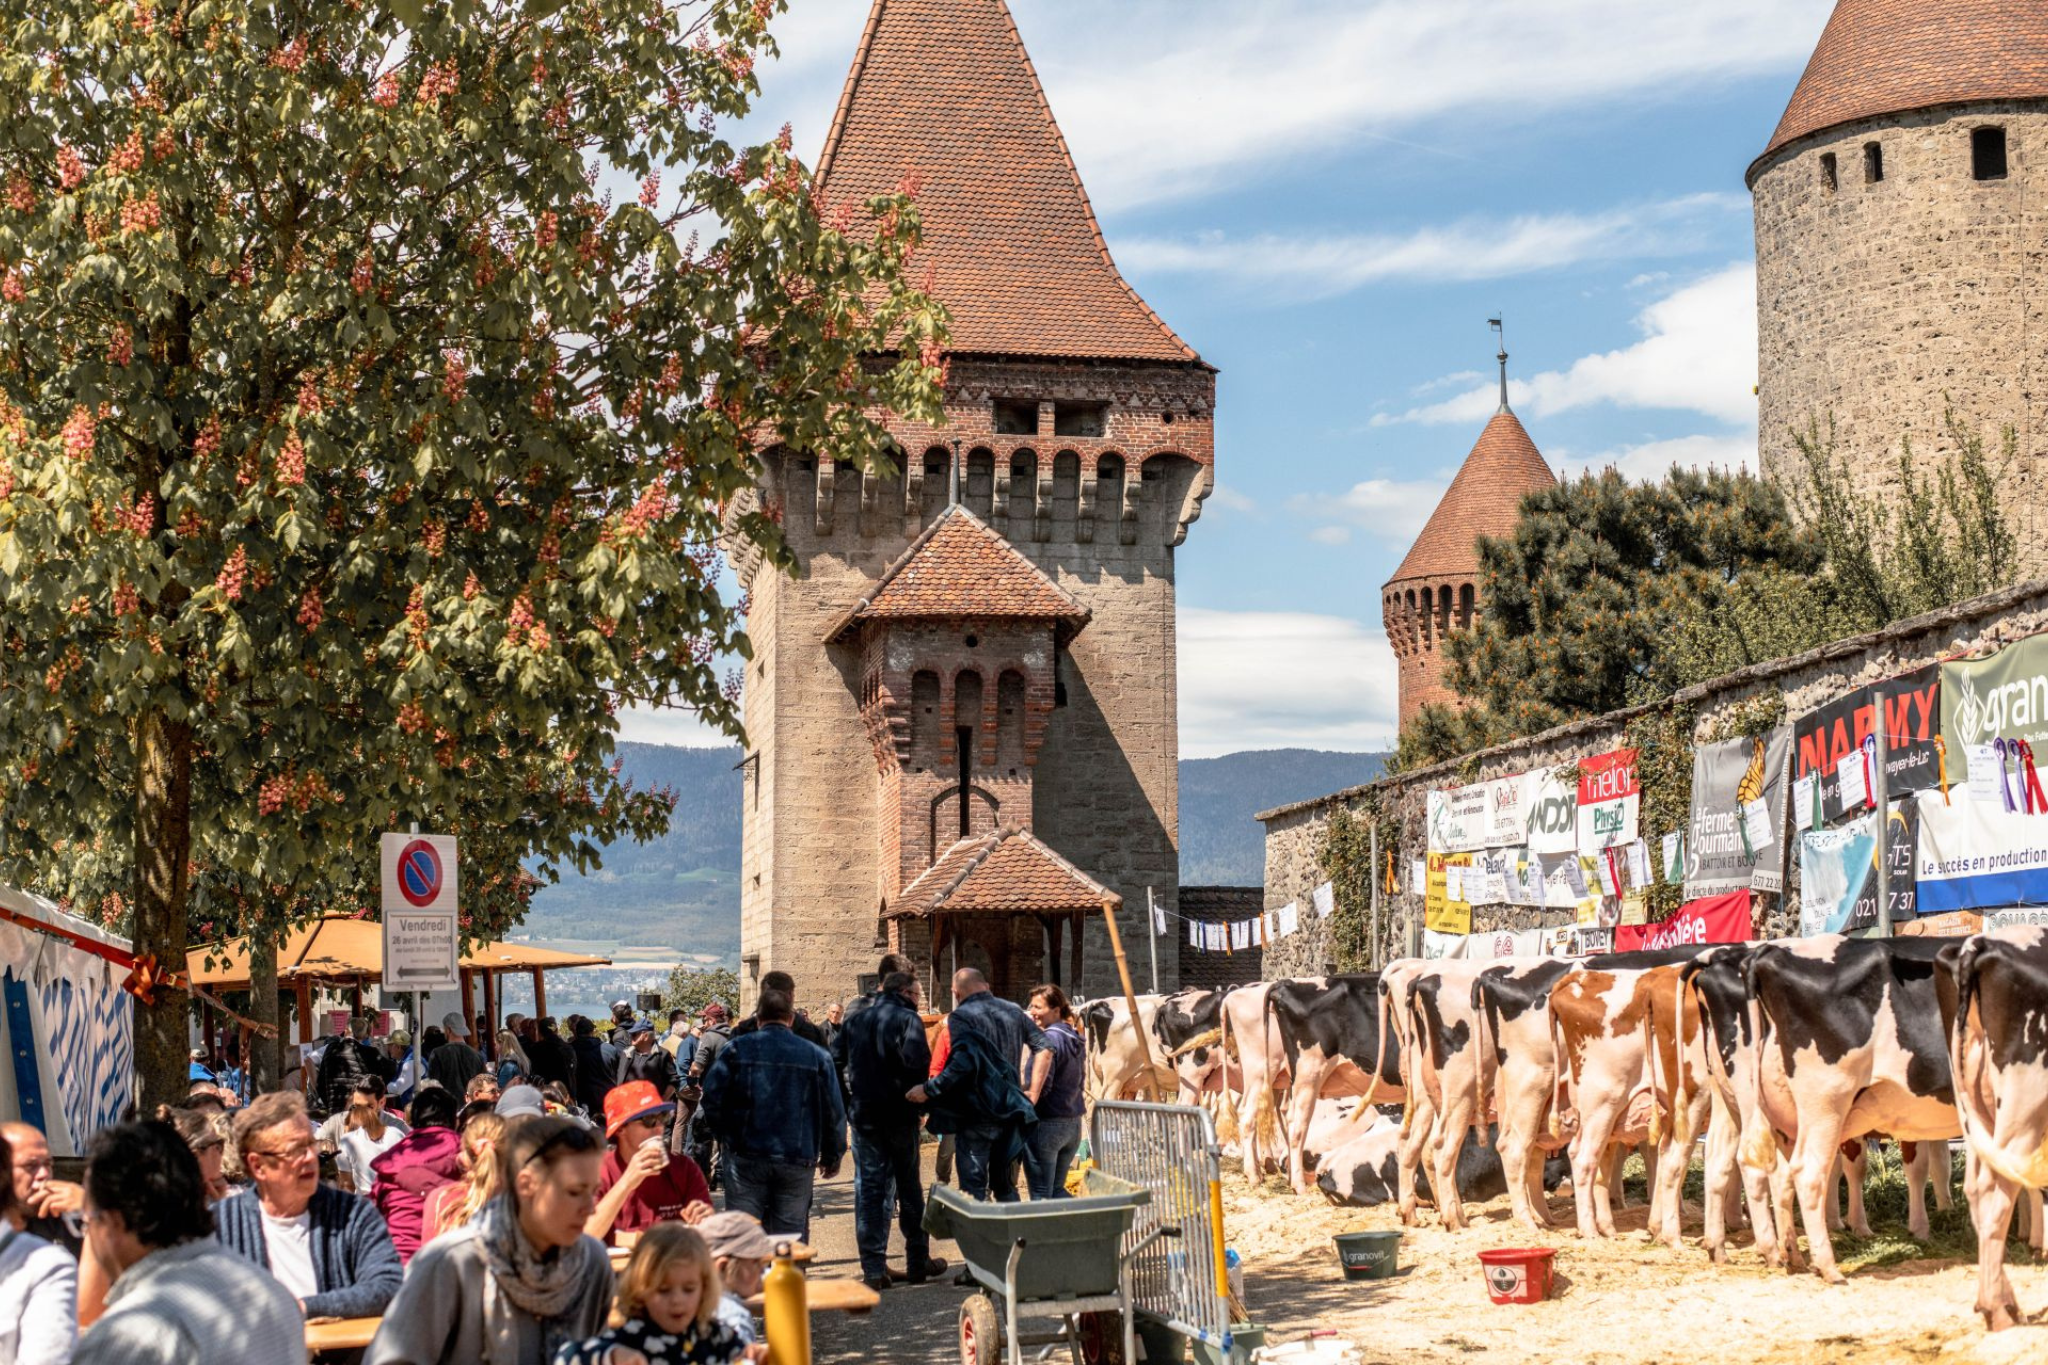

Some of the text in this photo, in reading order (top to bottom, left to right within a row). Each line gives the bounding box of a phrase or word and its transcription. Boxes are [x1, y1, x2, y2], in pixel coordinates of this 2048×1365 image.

[1799, 682, 1939, 779] MARMY
[1886, 750, 1930, 777] vayer-le-Lac
[1701, 806, 1735, 834] ferme
[1922, 847, 2048, 875] Le succès en production
[1855, 898, 1878, 918] 021
[400, 918, 447, 932] Vendredi
[403, 935, 418, 945] avril
[1584, 928, 1609, 949] BOVEY
[1349, 1251, 1385, 1264] granovit
